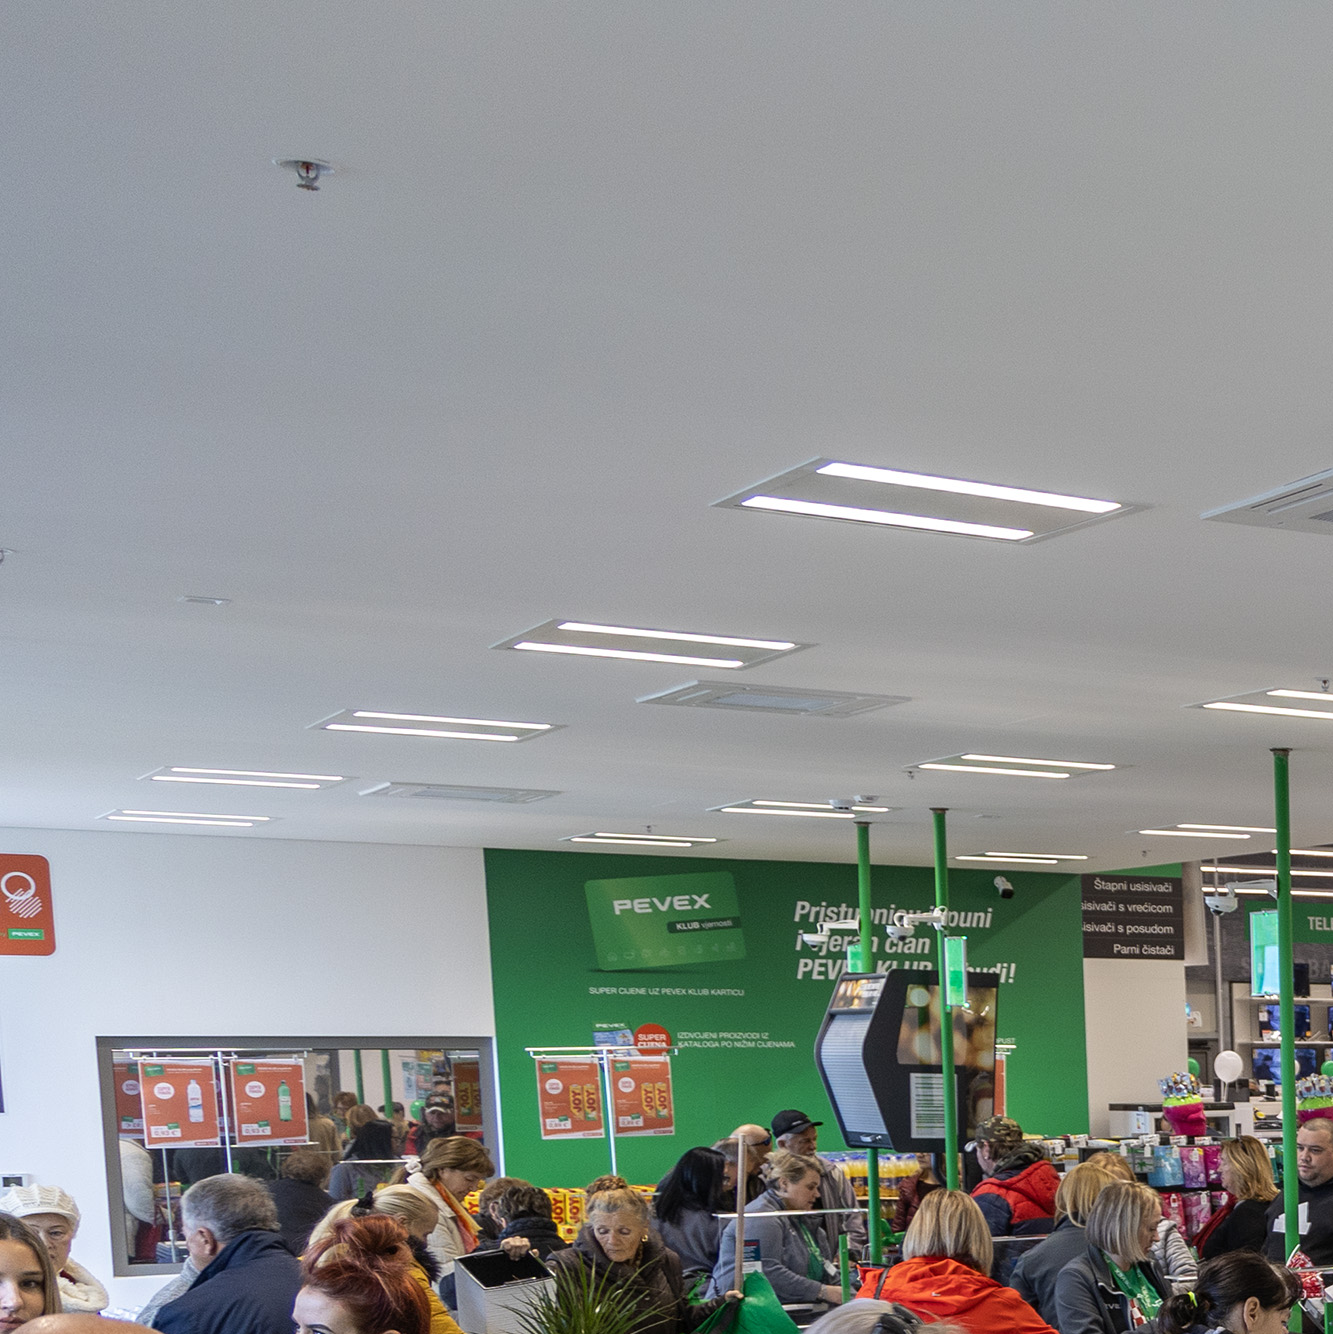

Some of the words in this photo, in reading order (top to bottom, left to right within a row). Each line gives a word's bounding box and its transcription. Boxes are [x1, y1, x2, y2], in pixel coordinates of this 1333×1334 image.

[1093, 877, 1127, 893] Štapni
[1129, 881, 1173, 892] usisivači
[613, 893, 712, 916] PEVEX
[1127, 902, 1174, 913] vrećicom
[676, 921, 700, 931] KLUB
[1126, 924, 1174, 935] posudom
[1113, 943, 1140, 954] Parni
[1141, 944, 1175, 955] čistači
[588, 986, 617, 995] SUPER
[618, 987, 648, 995] CIJENE
[648, 987, 661, 996] UZ
[661, 988, 687, 996] PEVEX
[687, 988, 710, 996] KLUB
[710, 988, 746, 997] KARTICU
[637, 1033, 667, 1042] SUPER
[720, 1040, 731, 1048] PO
[571, 1089, 582, 1112] JOY
[585, 1089, 597, 1113] JOY
[643, 1087, 654, 1111] JOY
[656, 1087, 667, 1111] JOY
